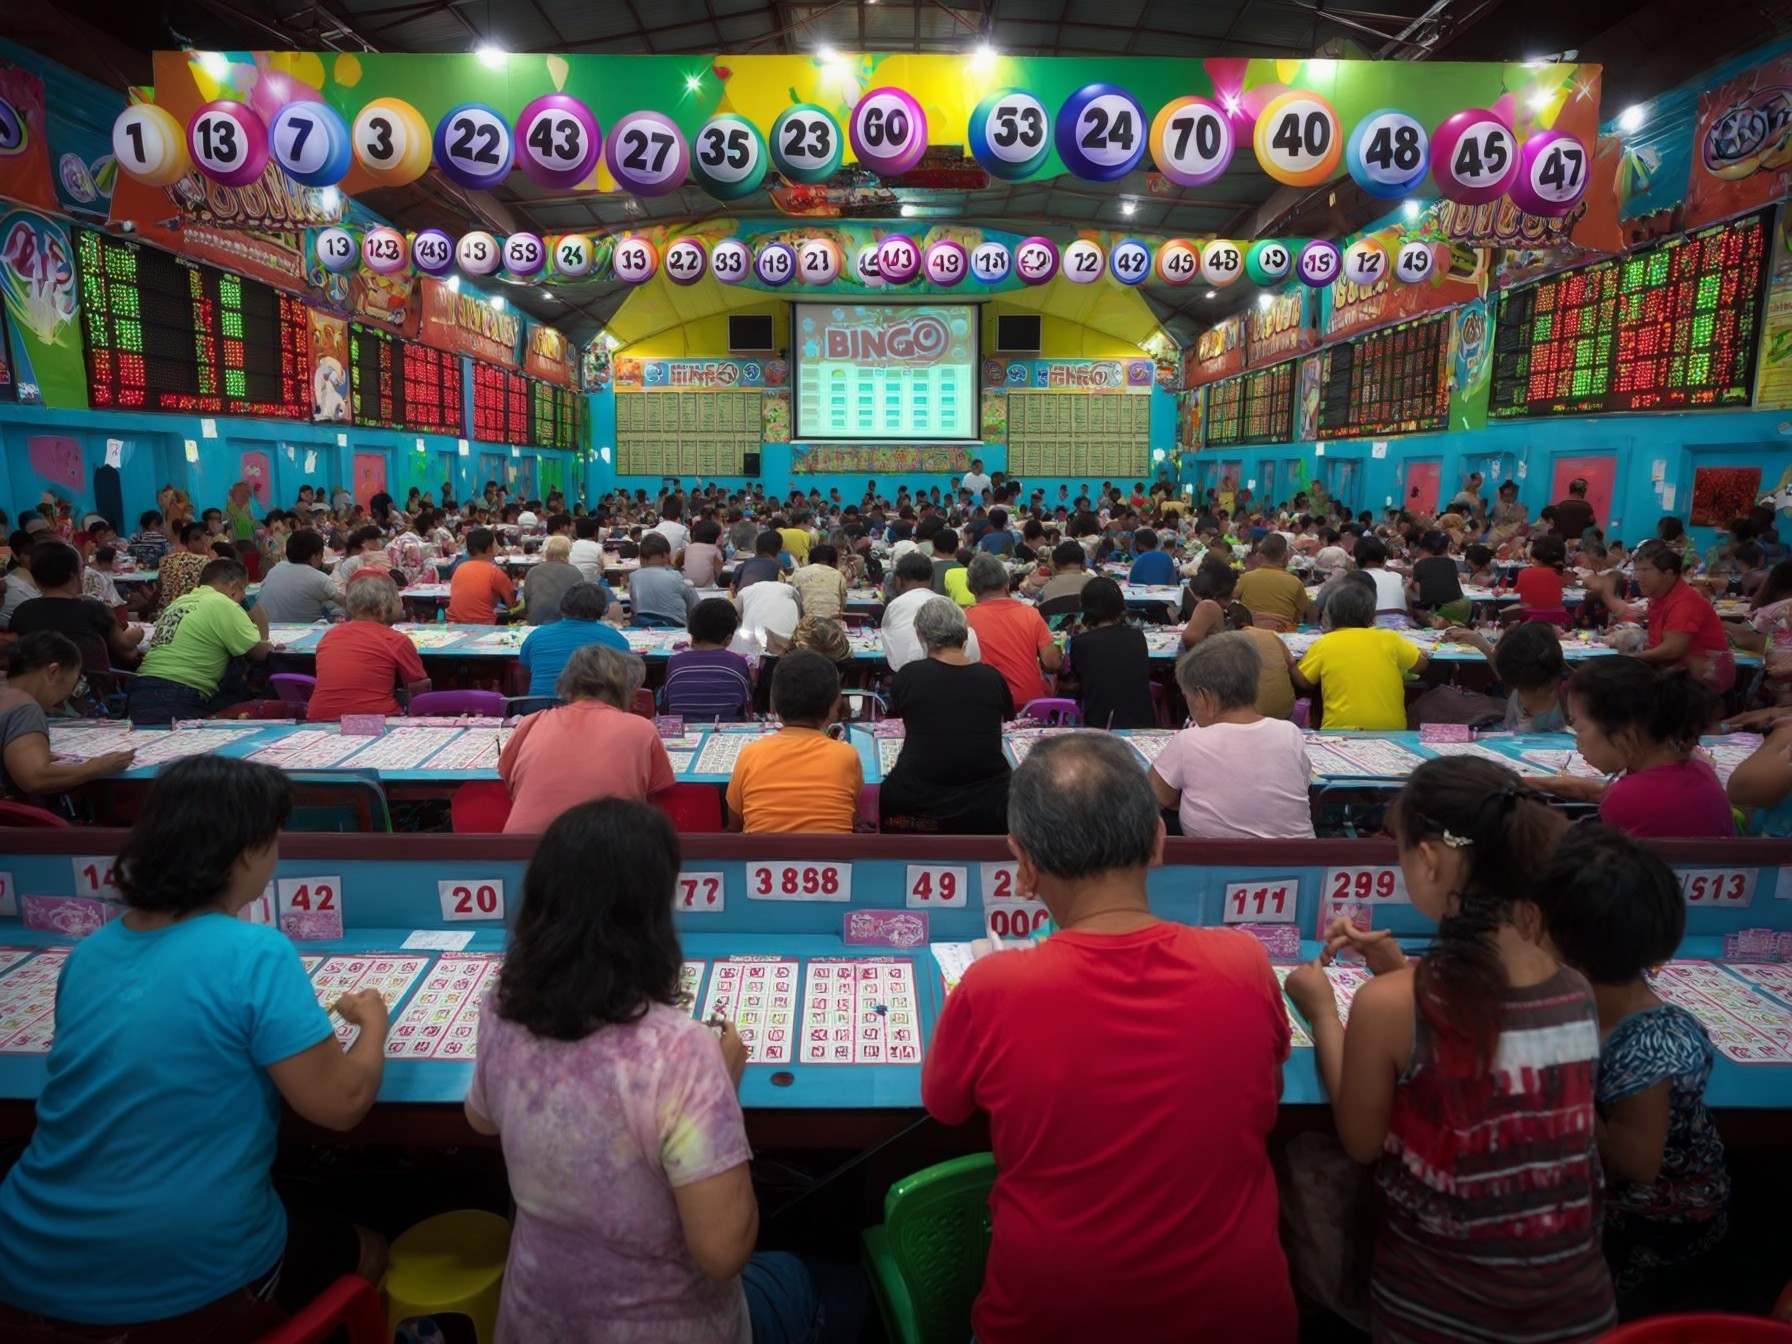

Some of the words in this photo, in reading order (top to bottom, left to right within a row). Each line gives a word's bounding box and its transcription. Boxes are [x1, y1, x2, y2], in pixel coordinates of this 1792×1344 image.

[126, 122, 146, 163] 1
[197, 118, 237, 162] 13
[287, 117, 314, 162] 7
[367, 118, 394, 160] 3
[450, 118, 500, 165] 22
[528, 118, 580, 160] 43
[784, 119, 830, 156] 23
[864, 107, 909, 147] 60
[994, 107, 1043, 147] 53
[1081, 107, 1133, 150] 24
[1172, 114, 1221, 160] 70
[1272, 111, 1330, 157] 40
[1366, 125, 1420, 171] 48
[623, 129, 674, 172] 27
[700, 128, 749, 169] 35
[1455, 131, 1507, 177] 45
[1539, 147, 1582, 191] 47
[827, 316, 949, 360] BINGO
[290, 884, 335, 911] 42
[452, 885, 497, 913] 20
[912, 871, 956, 900] 49
[1232, 887, 1288, 914] 111
[1332, 870, 1395, 899] 299
